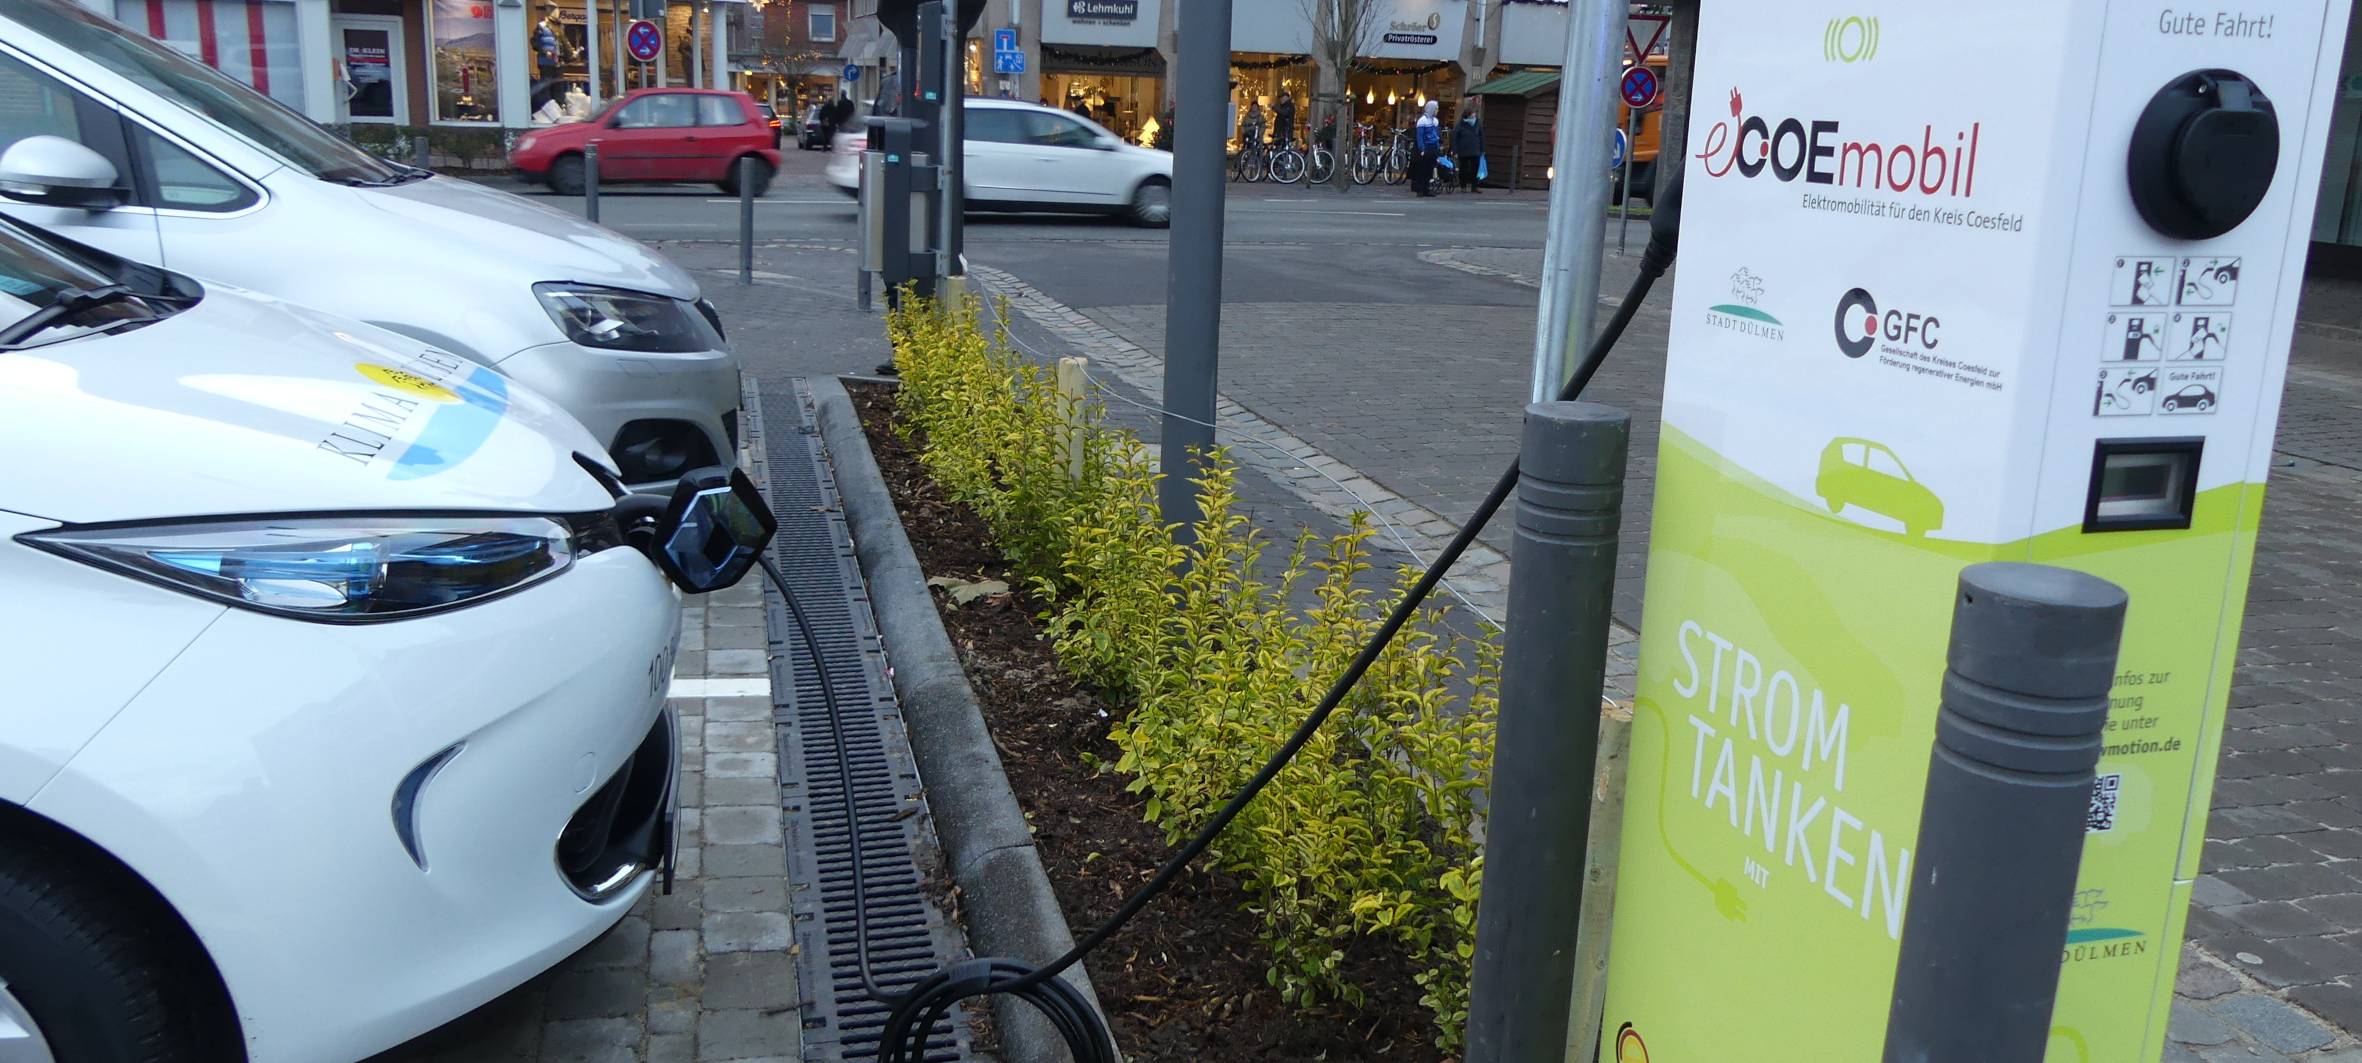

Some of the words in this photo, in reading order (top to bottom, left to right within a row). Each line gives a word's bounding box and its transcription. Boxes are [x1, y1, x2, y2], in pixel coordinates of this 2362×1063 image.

[1087, 2, 1134, 15] Lehmkuhl
[1387, 33, 1433, 44] Privatrösterei
[2159, 9, 2206, 36] Gute
[2214, 12, 2274, 39] Fahrt!
[1802, 193, 1887, 217] Elektromobilität
[1889, 201, 1906, 219] für
[1908, 206, 1931, 222] den
[1933, 208, 1964, 226] Kreis
[1966, 210, 2024, 232] Coesfeld
[1706, 313, 1737, 331] STADT
[1740, 320, 1784, 342] DÜLMEN
[1883, 309, 1940, 350] GFC
[1880, 344, 1918, 361] Gesellschaft
[1919, 353, 1931, 363] des
[1932, 355, 1957, 369] Kreises
[1958, 361, 1988, 377] Coesfeld
[1989, 370, 2001, 379] zur
[1880, 355, 1911, 371] Förderung
[1912, 363, 1954, 381] regenerativer
[1955, 372, 1985, 387] Energien
[1986, 381, 2003, 391] mbH
[2168, 371, 2189, 382] Gute
[2191, 371, 2216, 381] Fahrt!
[2113, 670, 2144, 687] nfos
[2148, 671, 2171, 685] zur
[1673, 618, 1849, 793] STROM
[2110, 695, 2144, 712] nung
[2121, 716, 2159, 731] unter
[1688, 713, 1910, 941] TANKEN
[1744, 856, 1770, 889] MIT
